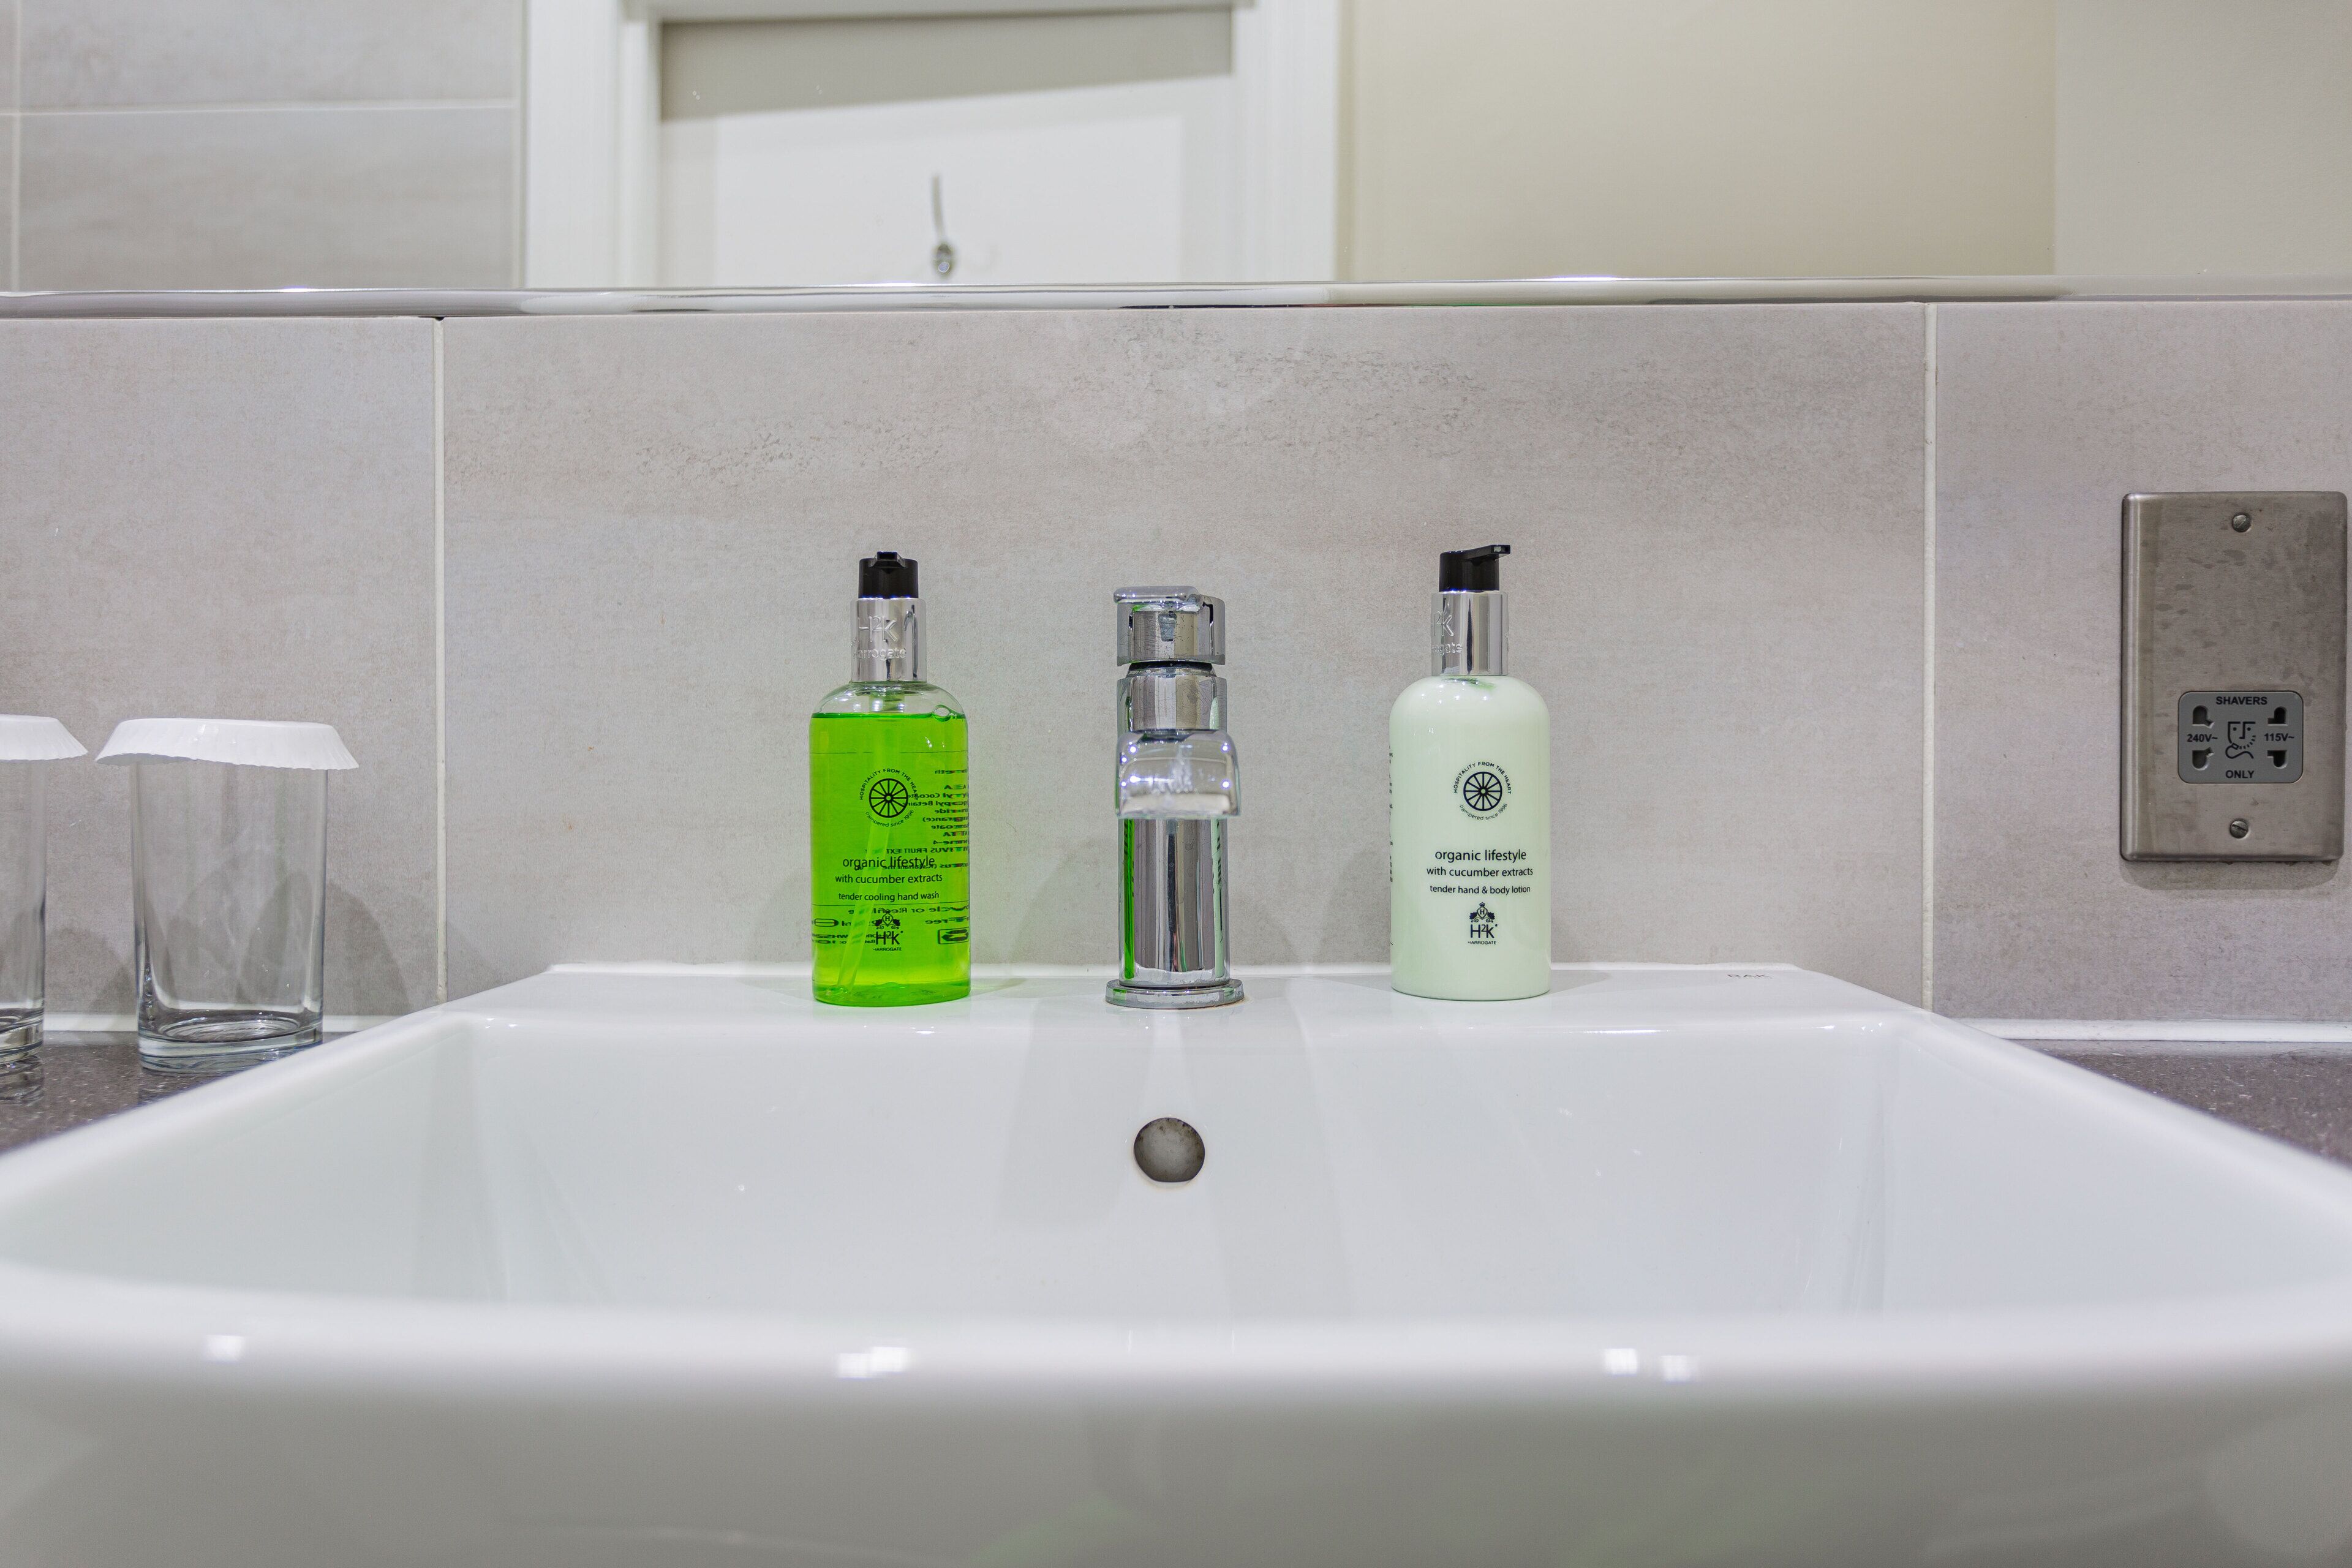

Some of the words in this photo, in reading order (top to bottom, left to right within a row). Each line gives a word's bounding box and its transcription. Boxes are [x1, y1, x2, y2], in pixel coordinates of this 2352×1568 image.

[2215, 696, 2267, 705] SHAVERS
[1453, 763, 1476, 793] HOSPITALITY
[1496, 765, 1506, 775] THE
[1503, 775, 1512, 794] HEART
[2225, 770, 2254, 778] ONLY
[859, 771, 881, 801] HOSPITALITY
[901, 772, 911, 782] THE
[910, 782, 919, 801] HEART
[1498, 803, 1508, 814] 1996
[903, 809, 914, 820] 1996
[1435, 850, 1482, 863] organic
[1484, 848, 1527, 864] lifestyle
[842, 856, 886, 870] organic
[890, 855, 935, 870] lifestyle
[1427, 866, 1447, 876] with
[1449, 867, 1500, 877] cucumber
[1501, 867, 1534, 876] extracts
[835, 874, 854, 883] with
[855, 874, 905, 884] cucumber
[907, 873, 943, 883] extracts
[1430, 884, 1457, 894] tender
[1458, 885, 1480, 894] hand
[1481, 886, 1488, 894] &
[1490, 886, 1510, 895] body
[1511, 884, 1531, 894] lotion
[839, 892, 863, 901] tender
[864, 892, 895, 903] cooling
[897, 892, 919, 901] hand
[920, 891, 940, 900] wash
